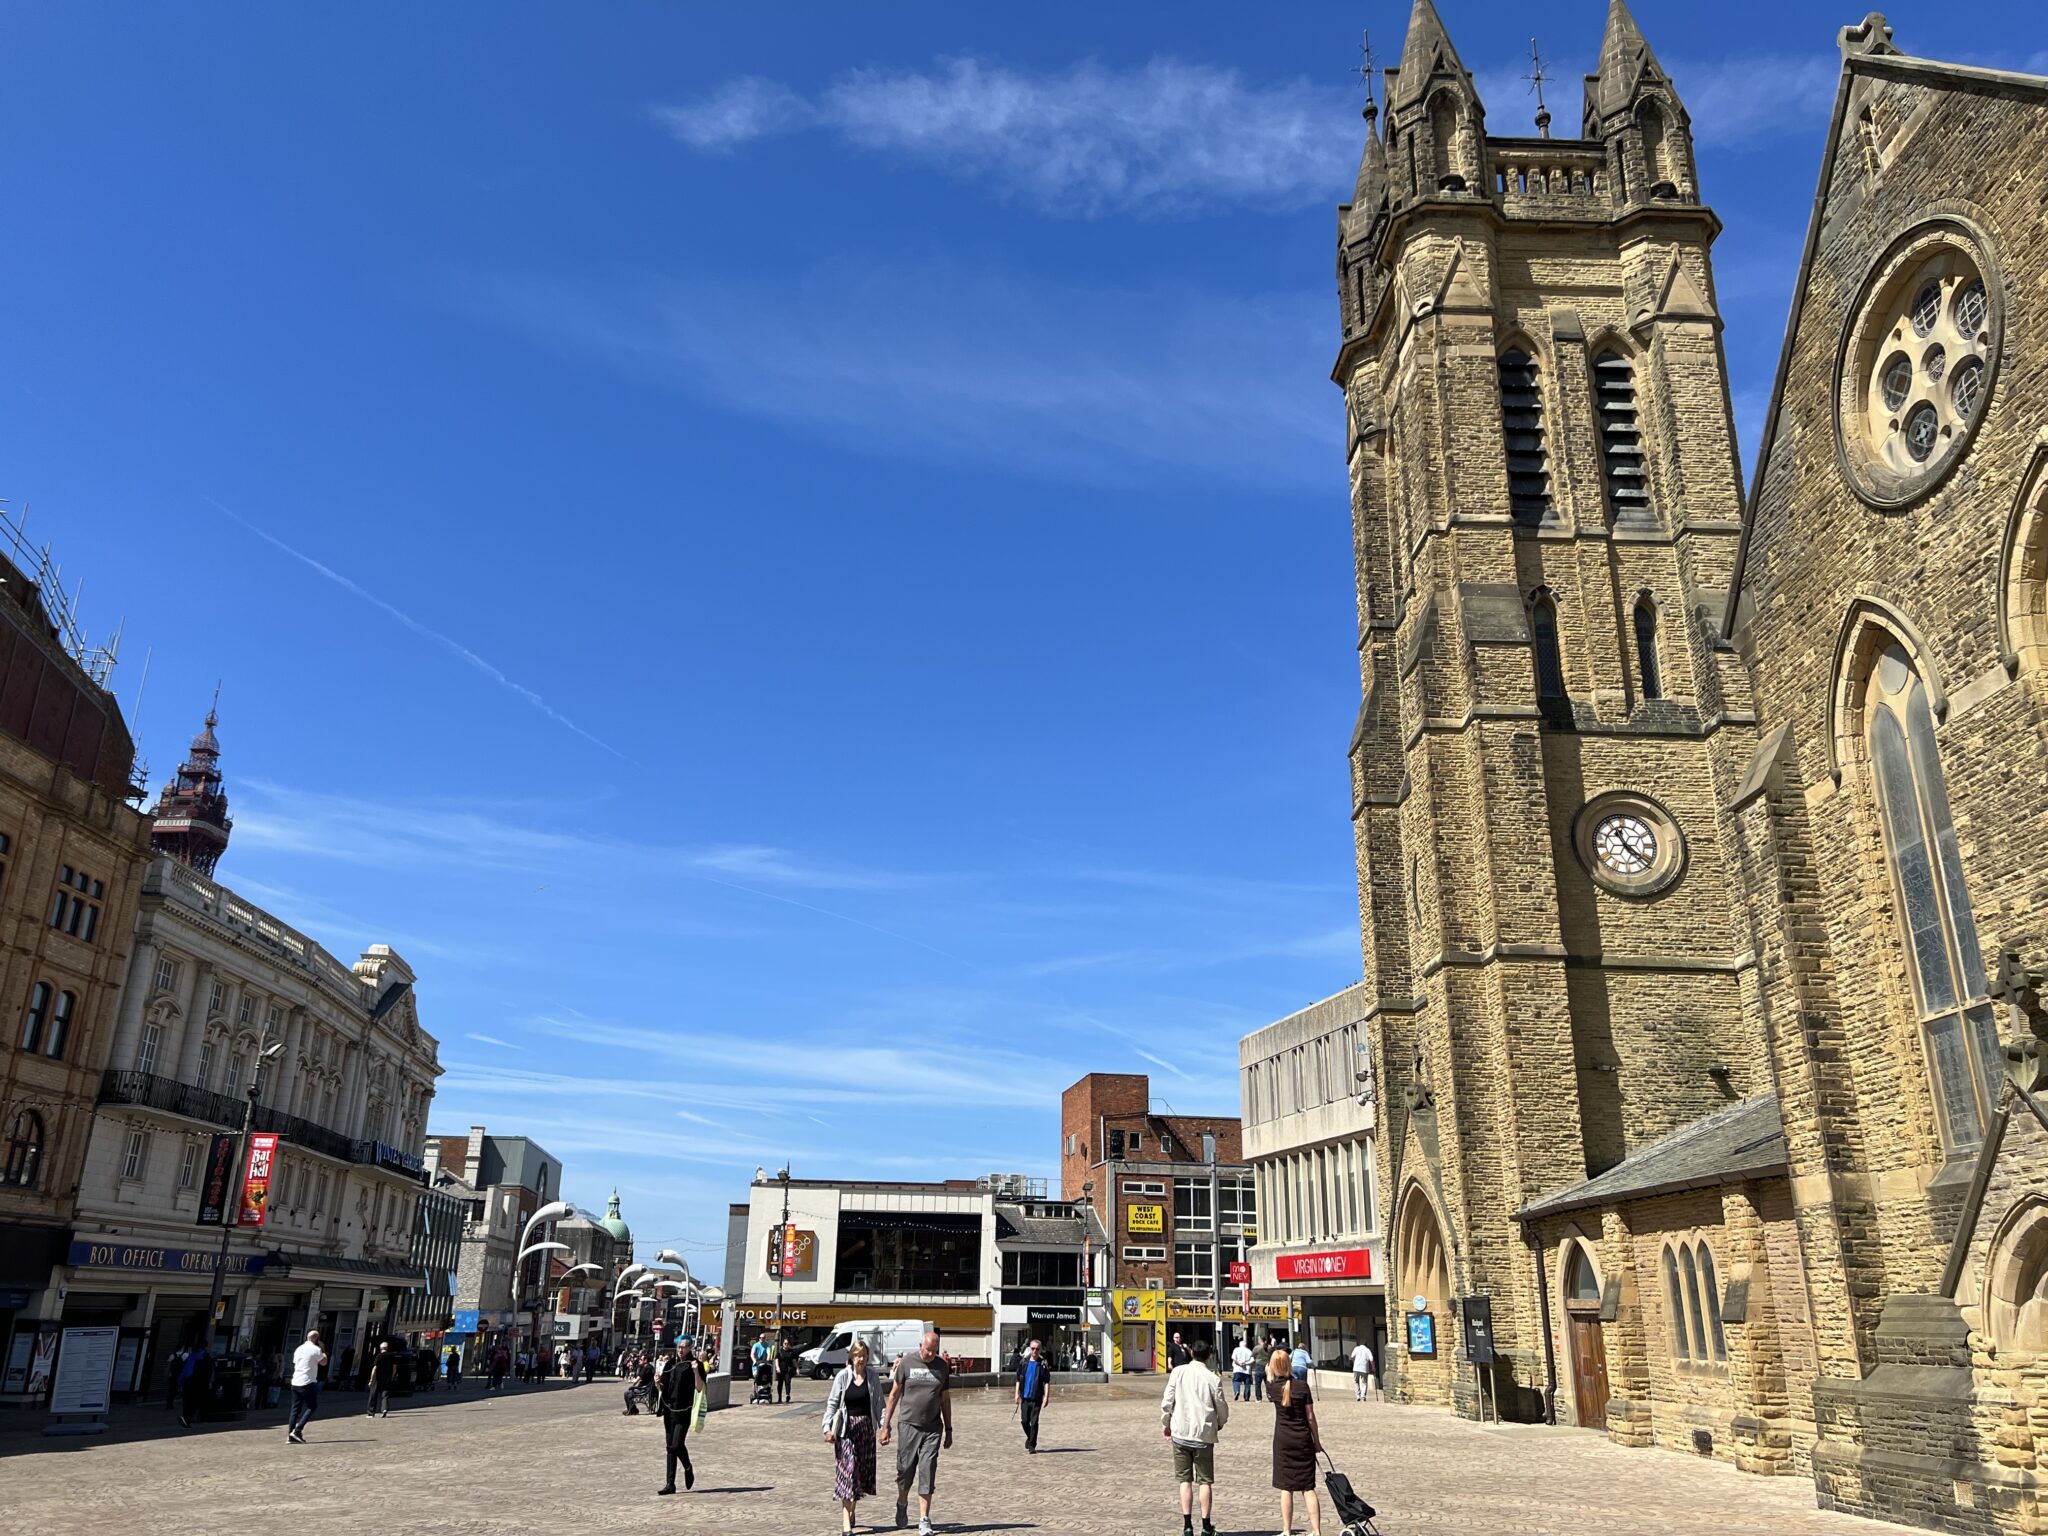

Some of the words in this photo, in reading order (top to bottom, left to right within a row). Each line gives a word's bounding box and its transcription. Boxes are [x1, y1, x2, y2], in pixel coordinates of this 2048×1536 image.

[251, 1149, 271, 1162] Bat
[248, 1162, 269, 1180] Hell
[89, 1246, 116, 1265] BOX
[122, 1248, 165, 1268] OFFICE
[181, 1252, 213, 1270] OPERA
[1293, 1258, 1317, 1275] VIRGIN
[1317, 1256, 1346, 1273] MONEY
[712, 1309, 755, 1320] VITRO
[759, 1310, 807, 1320] LONGE
[1031, 1311, 1055, 1319] Warren
[1056, 1312, 1077, 1320] James
[1187, 1305, 1210, 1314] WEST
[1211, 1305, 1236, 1315] CAST
[1239, 1305, 1260, 1316] RCK
[1262, 1306, 1281, 1316] CAFE
